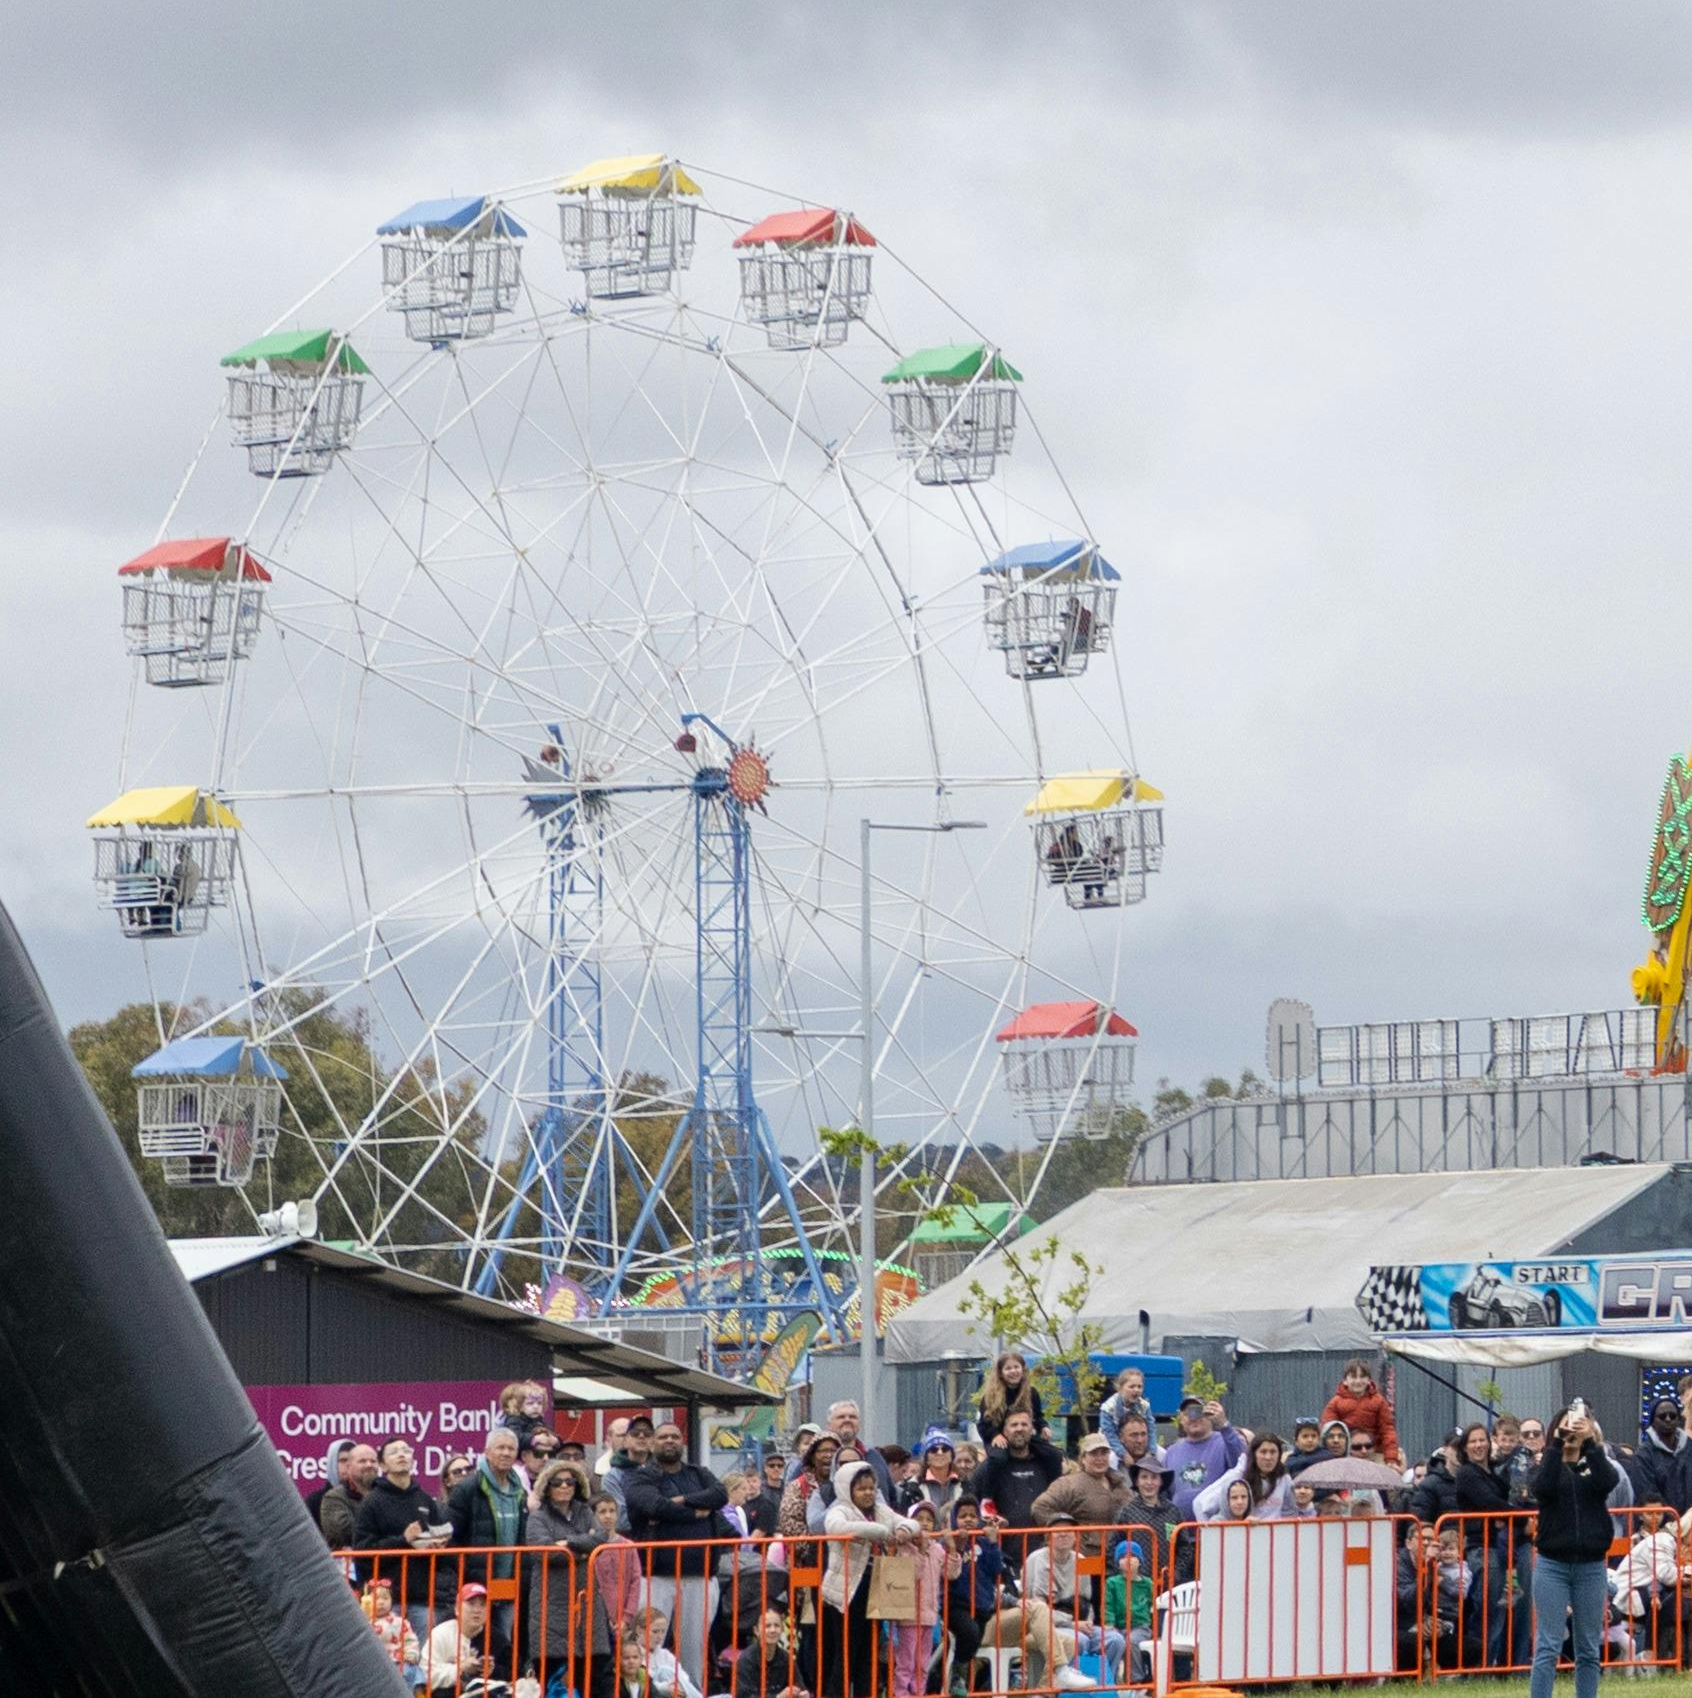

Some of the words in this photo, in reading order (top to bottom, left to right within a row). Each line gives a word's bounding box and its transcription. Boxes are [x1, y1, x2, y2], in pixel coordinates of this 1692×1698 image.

[1517, 1265, 1586, 1285] START
[281, 1401, 433, 1441] Community
[439, 1401, 504, 1433] Bank
